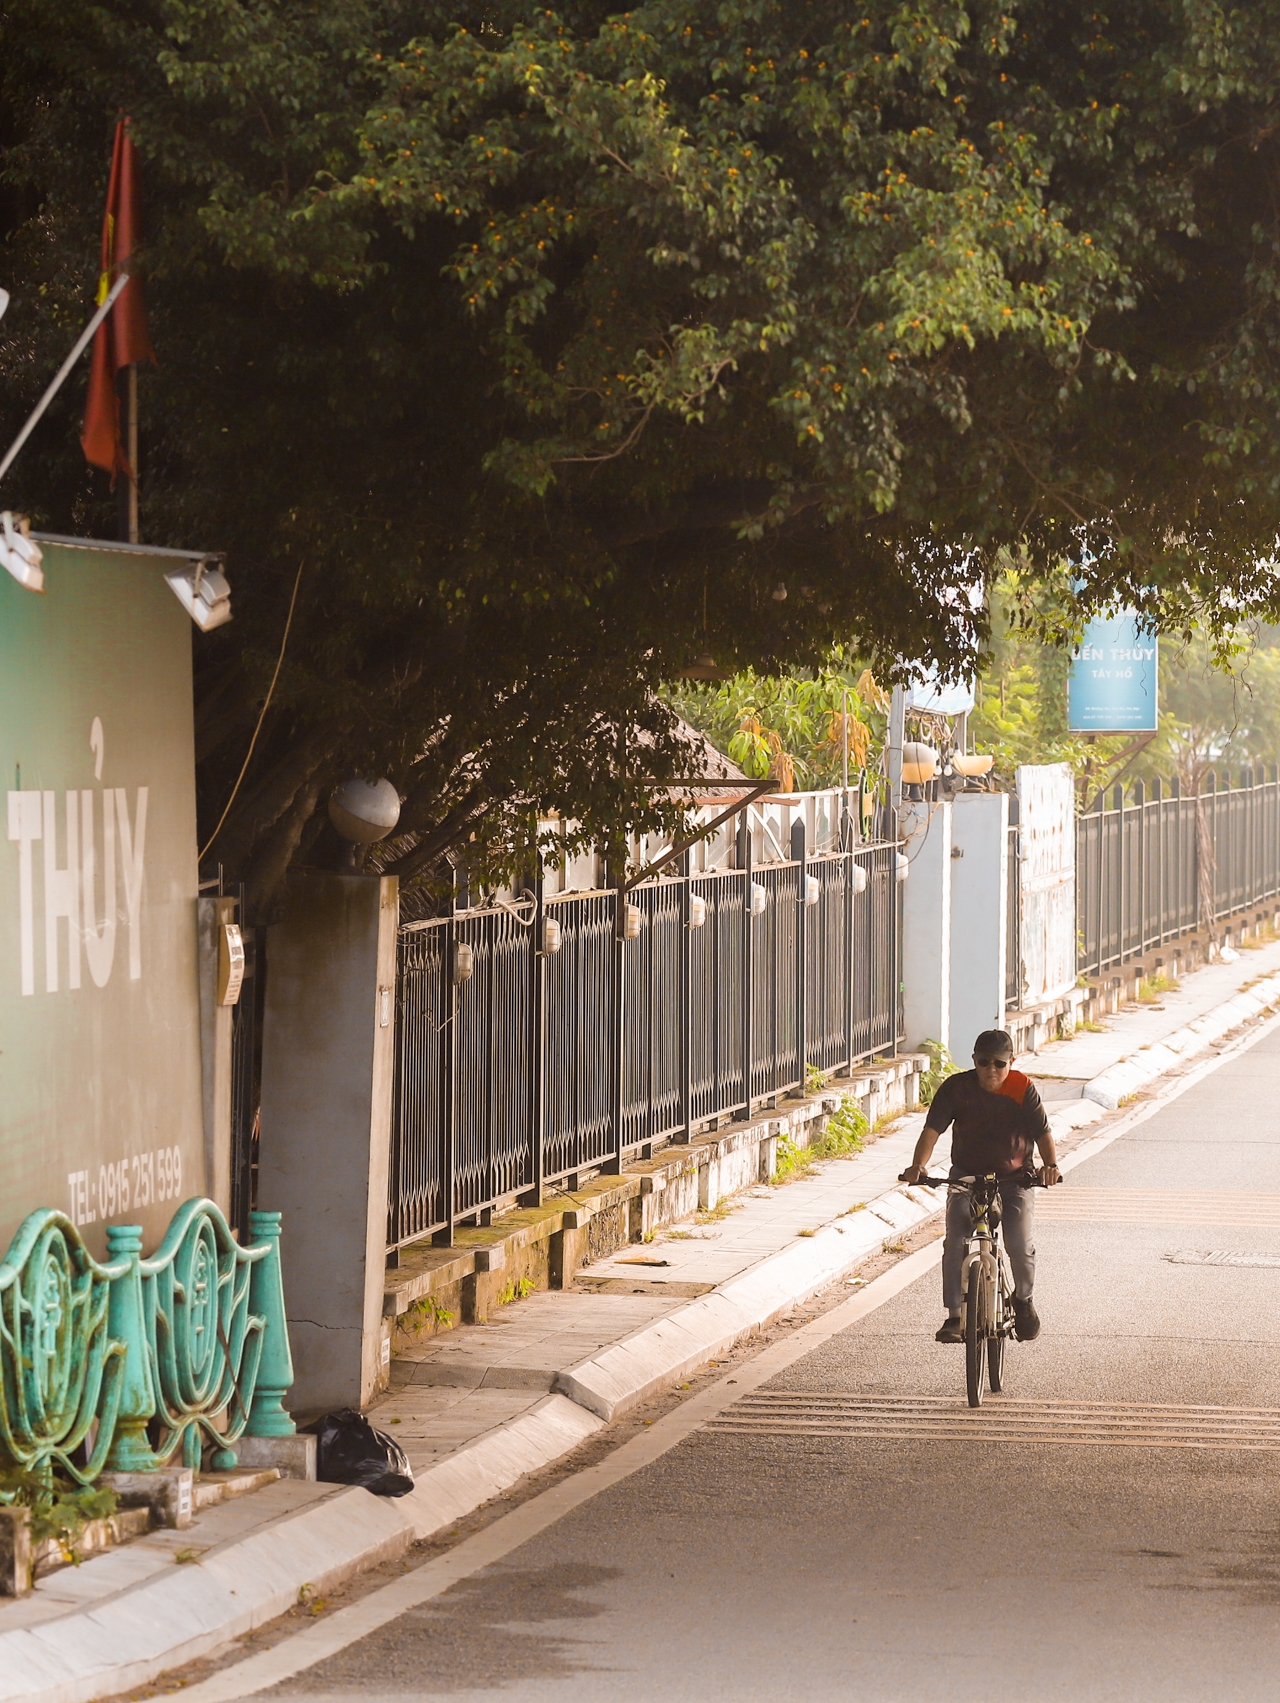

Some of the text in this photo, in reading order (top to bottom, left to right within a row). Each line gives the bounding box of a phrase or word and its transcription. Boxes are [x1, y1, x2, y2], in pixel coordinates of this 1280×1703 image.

[1092, 668, 1112, 678] TÂY
[7, 716, 148, 996] THỦY
[68, 1145, 182, 1226] TEL: 0915 251 599
